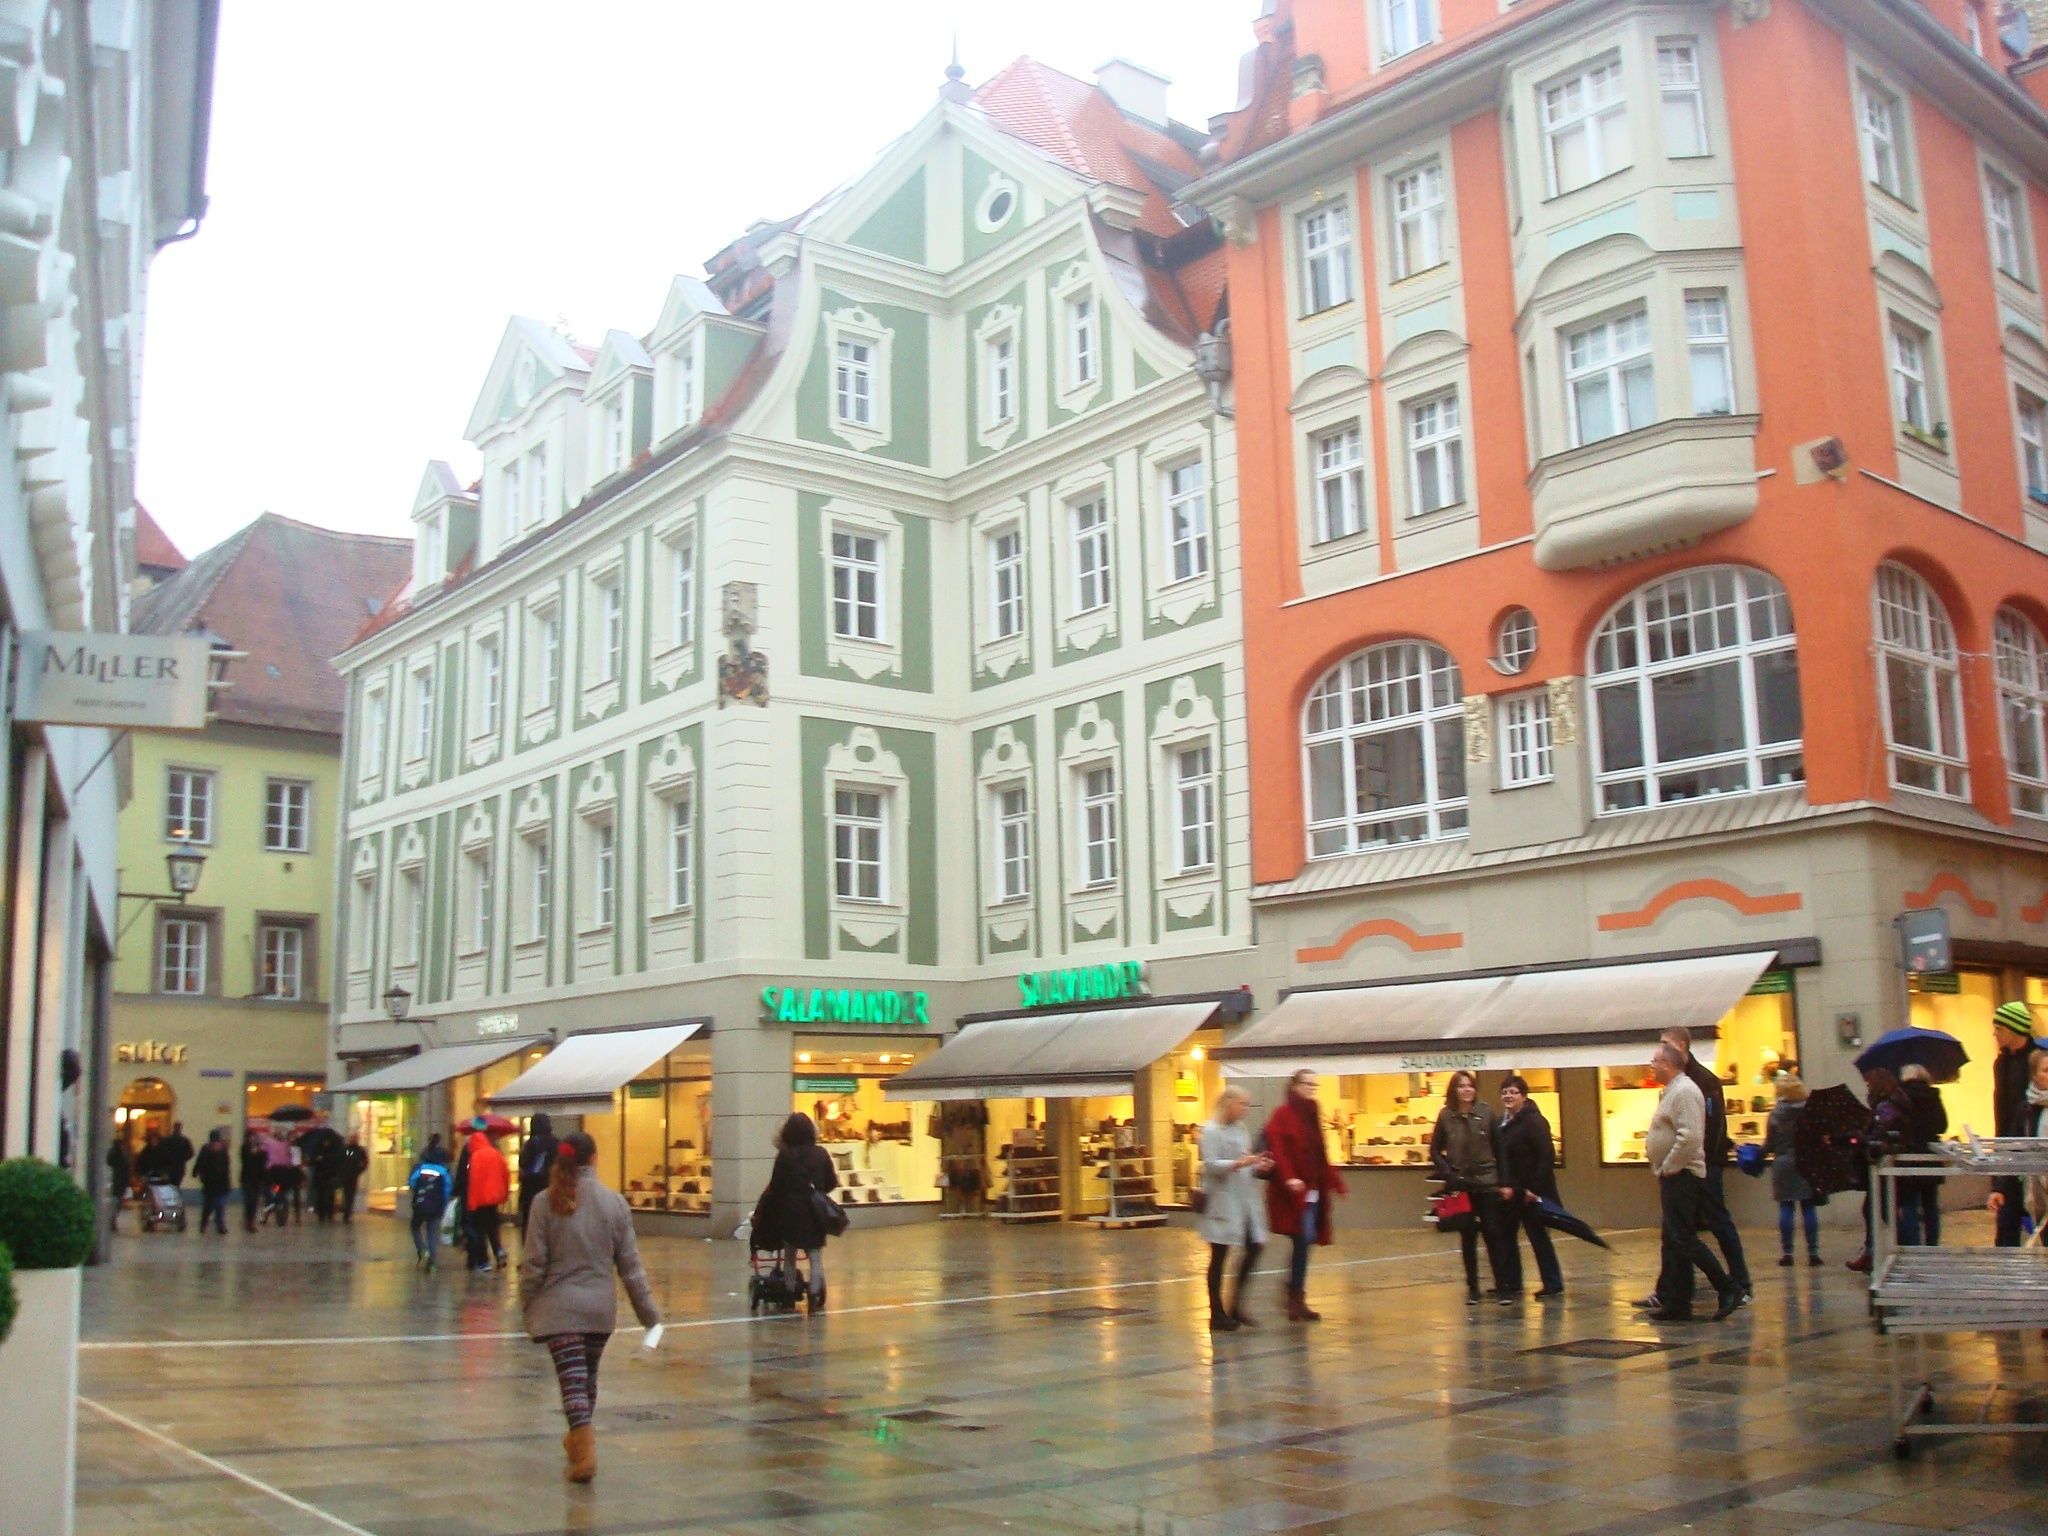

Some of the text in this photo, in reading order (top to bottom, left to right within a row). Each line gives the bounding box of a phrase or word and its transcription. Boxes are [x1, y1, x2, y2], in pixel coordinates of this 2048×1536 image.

[42, 645, 179, 683] MILLER
[1018, 960, 1150, 1008] SALAMANDER
[759, 986, 930, 1024] SALAMANDER
[1400, 1053, 1487, 1069] SALAMANDER
